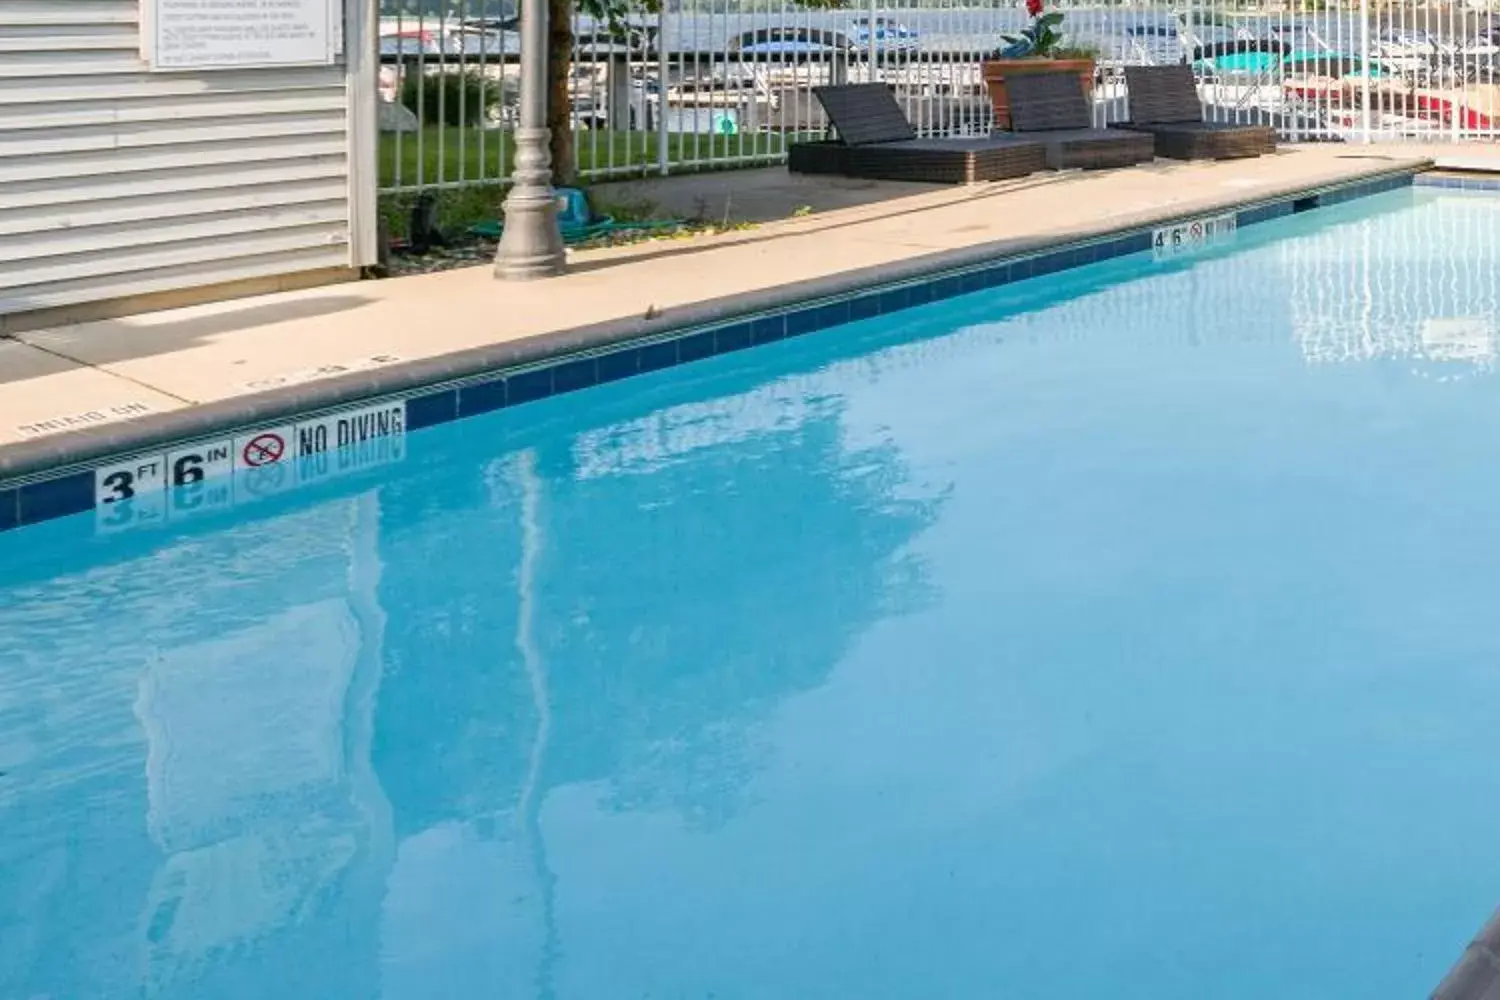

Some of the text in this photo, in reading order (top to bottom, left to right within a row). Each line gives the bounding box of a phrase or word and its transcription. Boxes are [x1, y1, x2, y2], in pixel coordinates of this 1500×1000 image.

[1155, 231, 1164, 247] 4
[103, 407, 402, 504] 3 FT 6 IN NO DIVING
